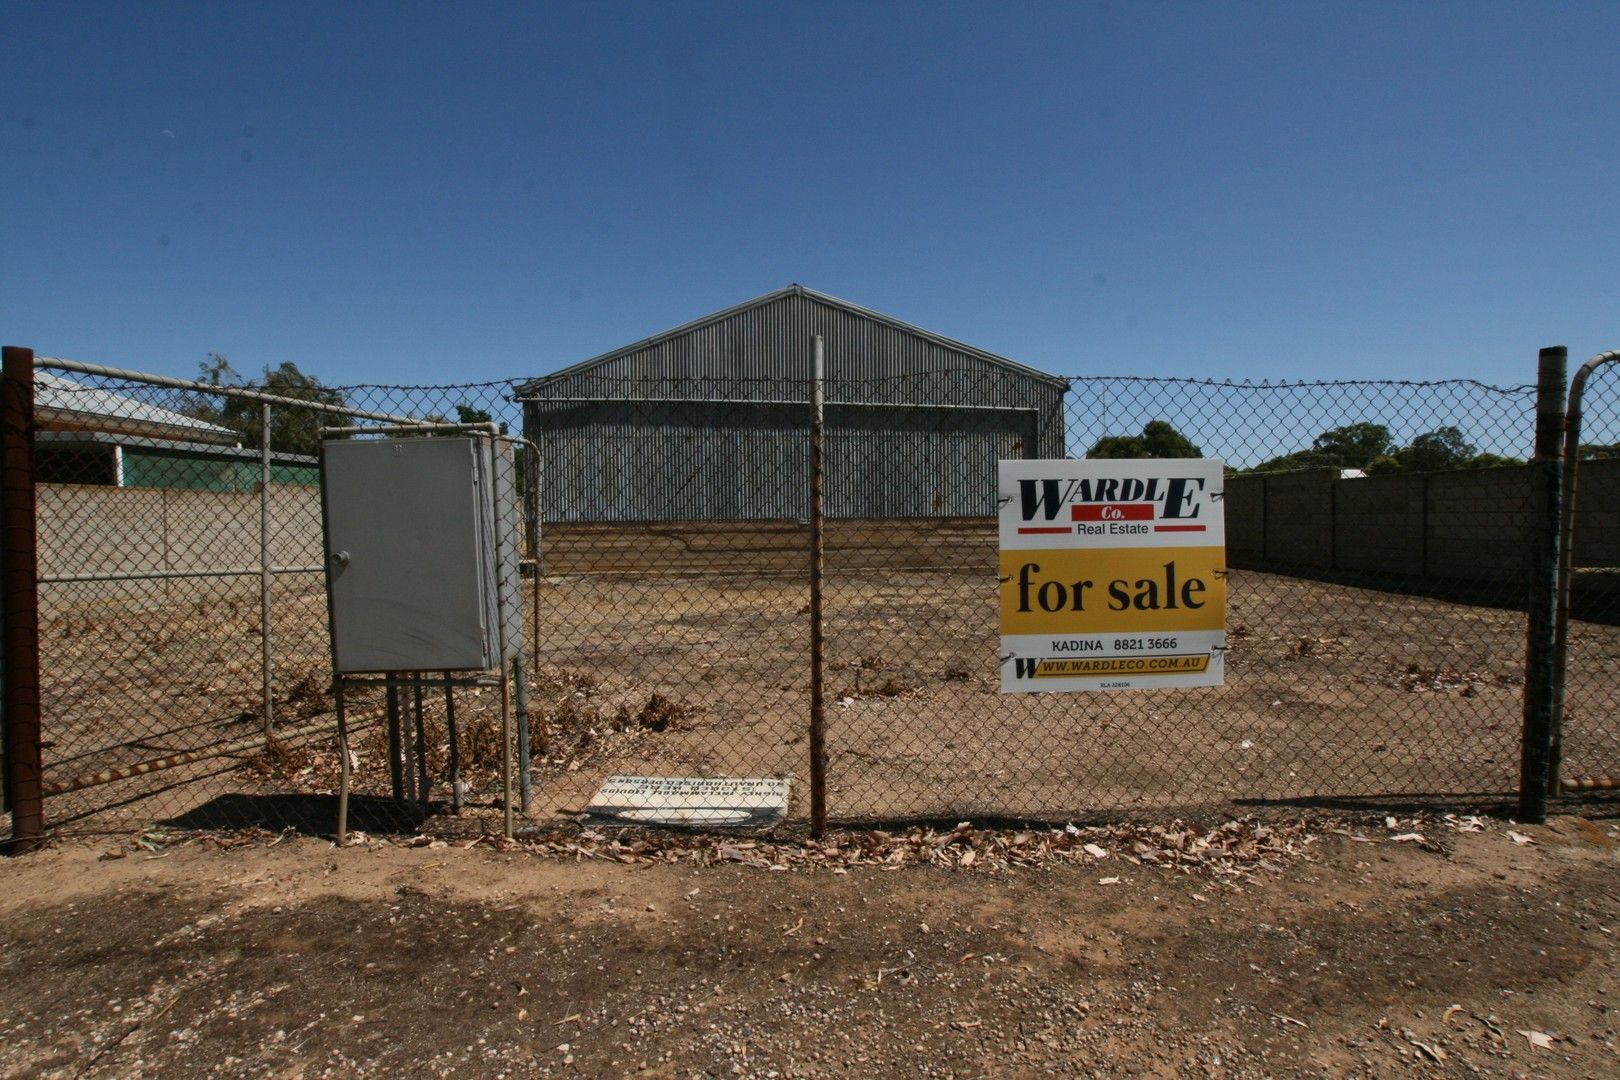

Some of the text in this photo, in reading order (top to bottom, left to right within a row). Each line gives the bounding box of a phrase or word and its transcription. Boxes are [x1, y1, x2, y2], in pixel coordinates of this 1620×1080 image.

[1017, 478, 1205, 521] WARDLE
[1100, 505, 1126, 520] Co.
[1077, 523, 1149, 535] Real Estate
[1016, 561, 1206, 613] for sale
[1052, 638, 1177, 652] KADINA 8821 3666
